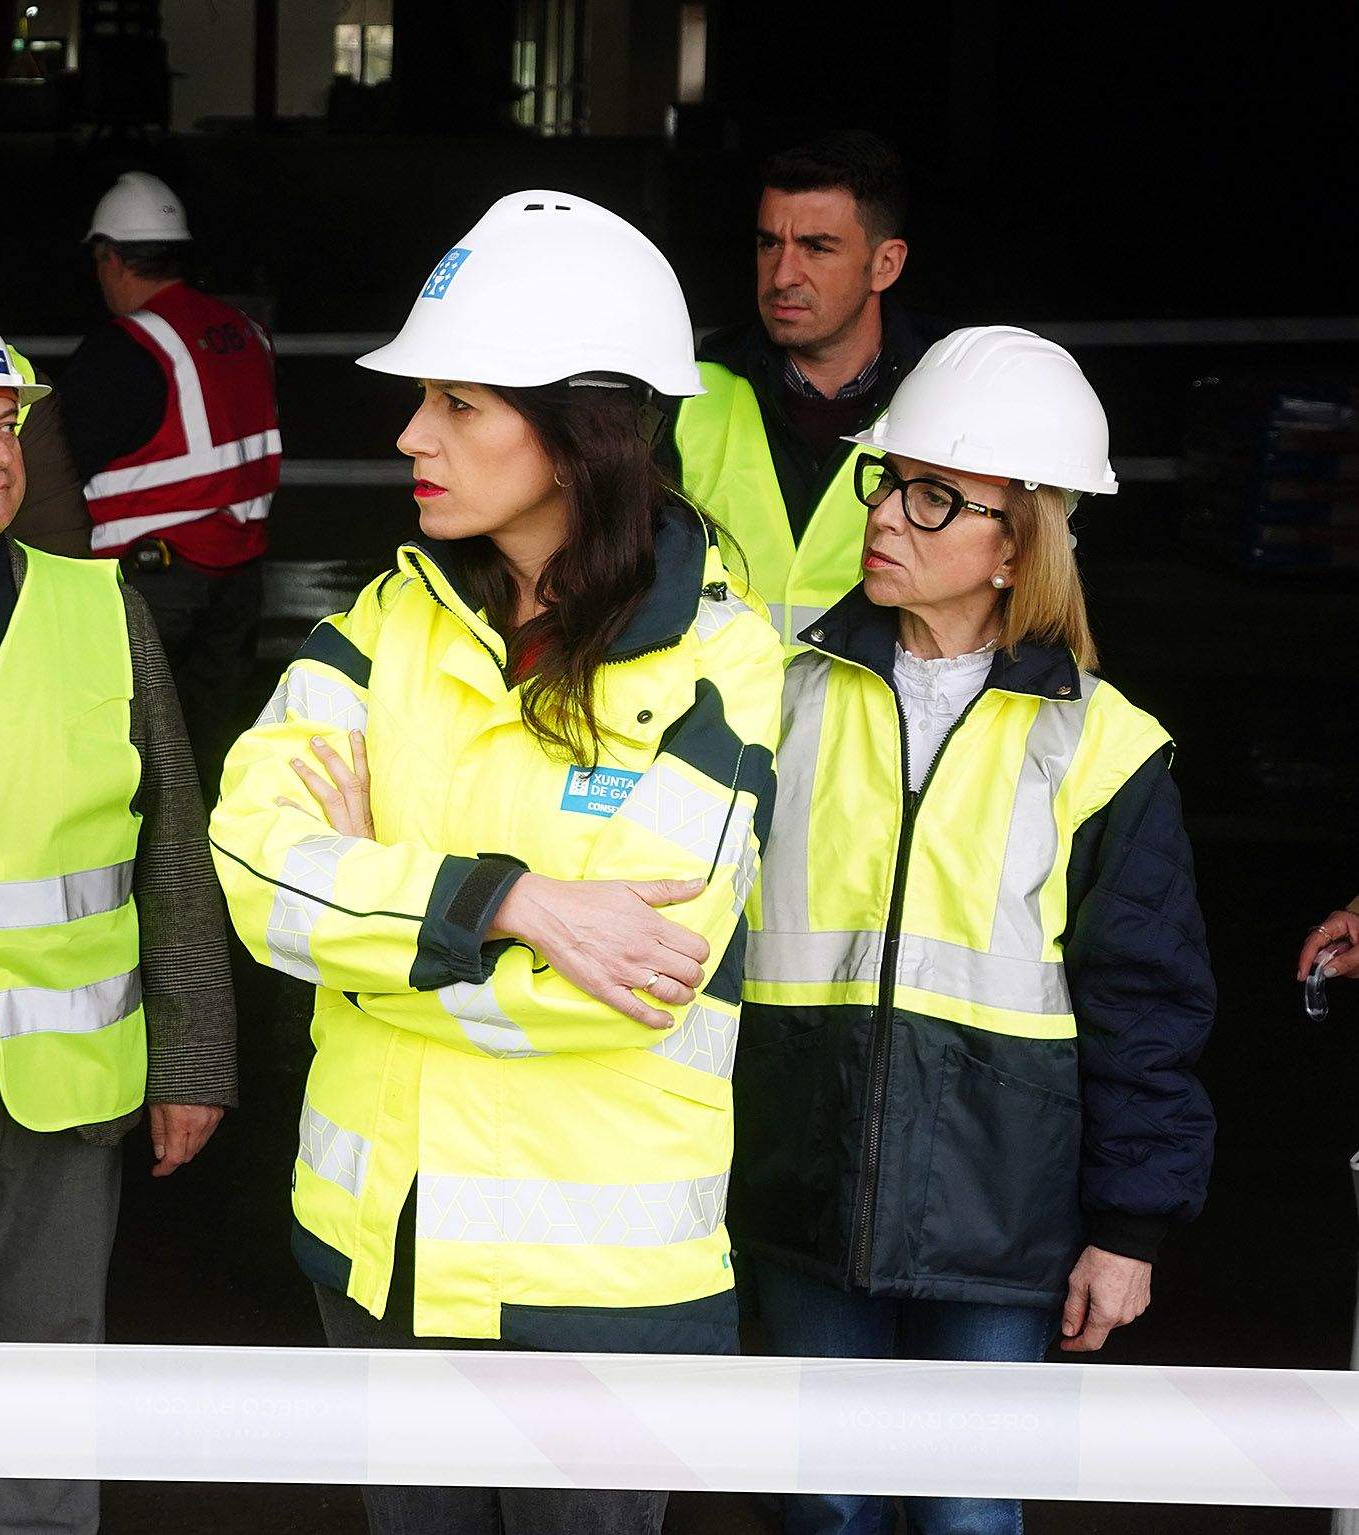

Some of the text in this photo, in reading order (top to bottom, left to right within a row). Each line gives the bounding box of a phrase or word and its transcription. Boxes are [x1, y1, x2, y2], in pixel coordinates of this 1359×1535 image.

[593, 773, 635, 789] XUNTA
[591, 785, 628, 800] DE GA
[587, 802, 618, 814] CONSE
